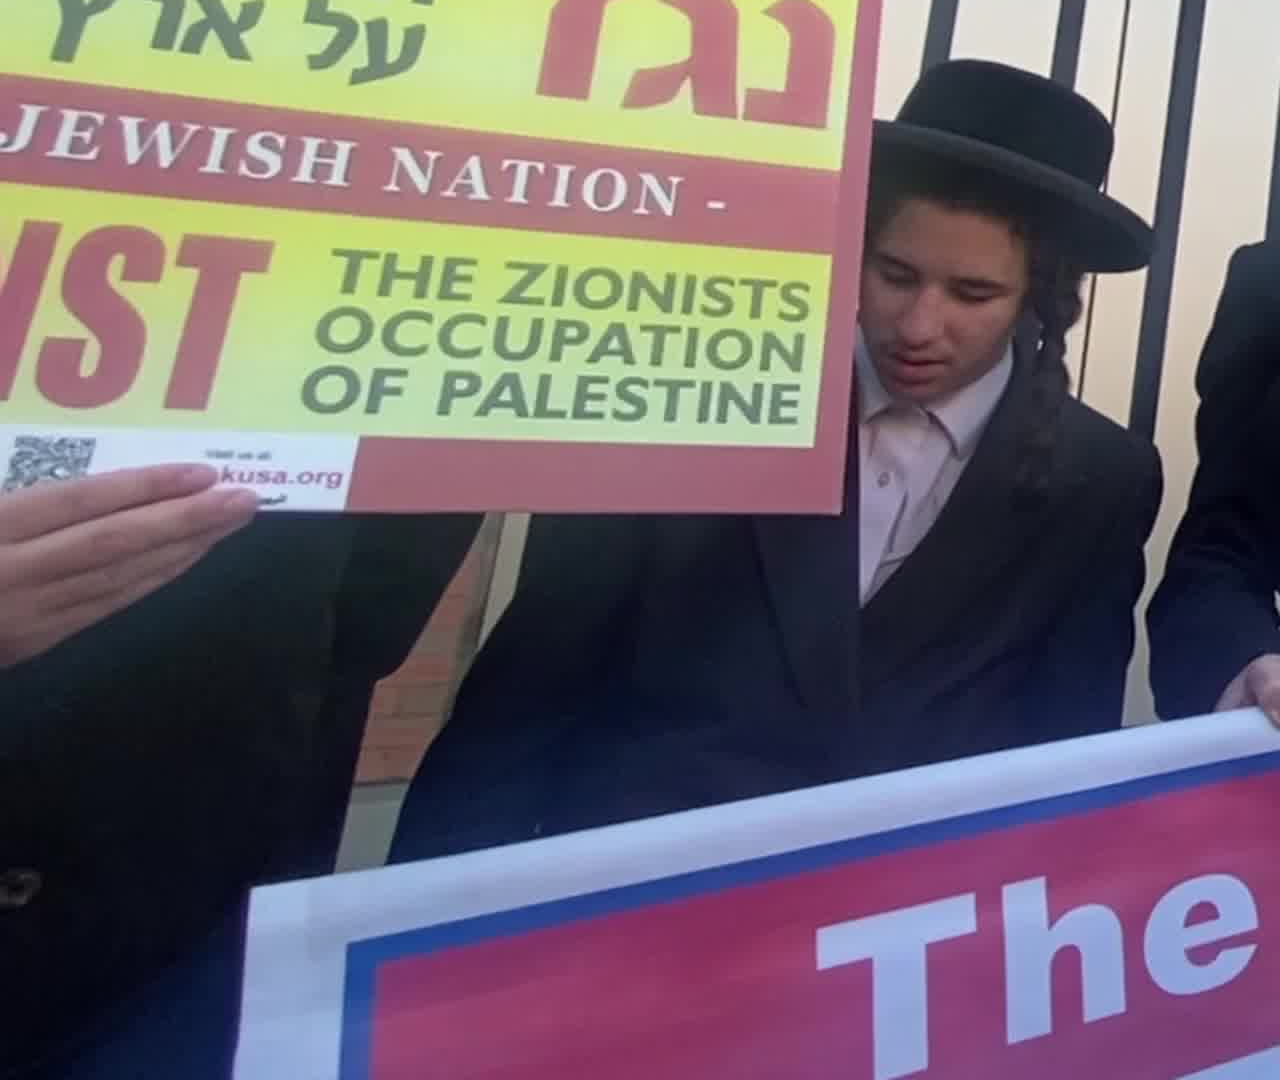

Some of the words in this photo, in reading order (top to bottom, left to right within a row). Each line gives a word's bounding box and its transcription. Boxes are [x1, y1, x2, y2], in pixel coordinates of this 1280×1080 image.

[0, 103, 358, 187] JEWISH
[382, 145, 684, 218] NATION
[331, 248, 478, 304] THE
[498, 262, 812, 323] ZIONISTS
[315, 307, 805, 374] OCCUPATION
[300, 365, 410, 417] OF
[437, 373, 802, 427] PALESTINE
[221, 466, 345, 489] kusa.org
[815, 872, 1260, 1080] The
